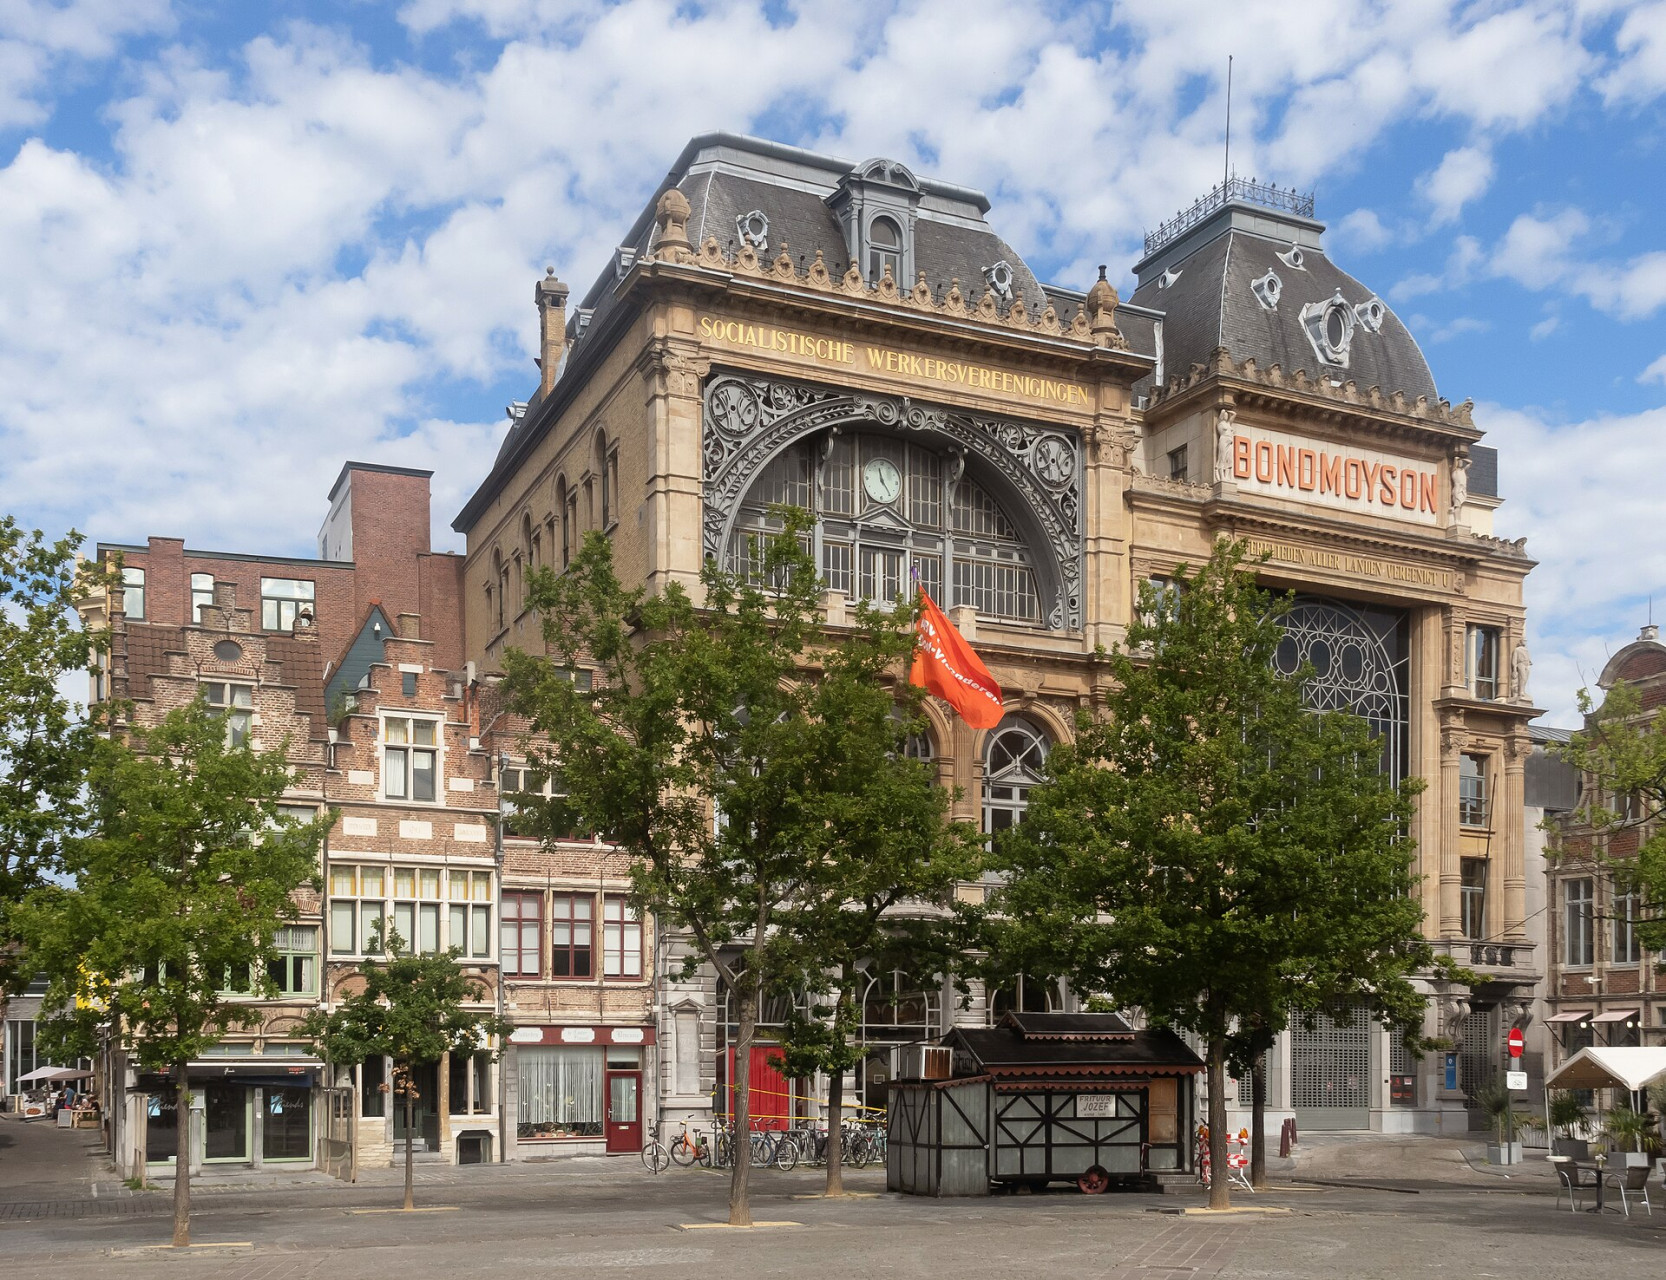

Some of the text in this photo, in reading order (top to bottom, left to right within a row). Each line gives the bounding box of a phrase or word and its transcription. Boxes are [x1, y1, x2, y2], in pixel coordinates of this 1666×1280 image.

[700, 316, 1089, 405] SOCIALISTISCHE WERKERSVEREENIGINGEN
[1243, 539, 1449, 588] ERKLIEDEN ALLER LANDEN VEREENIGT U
